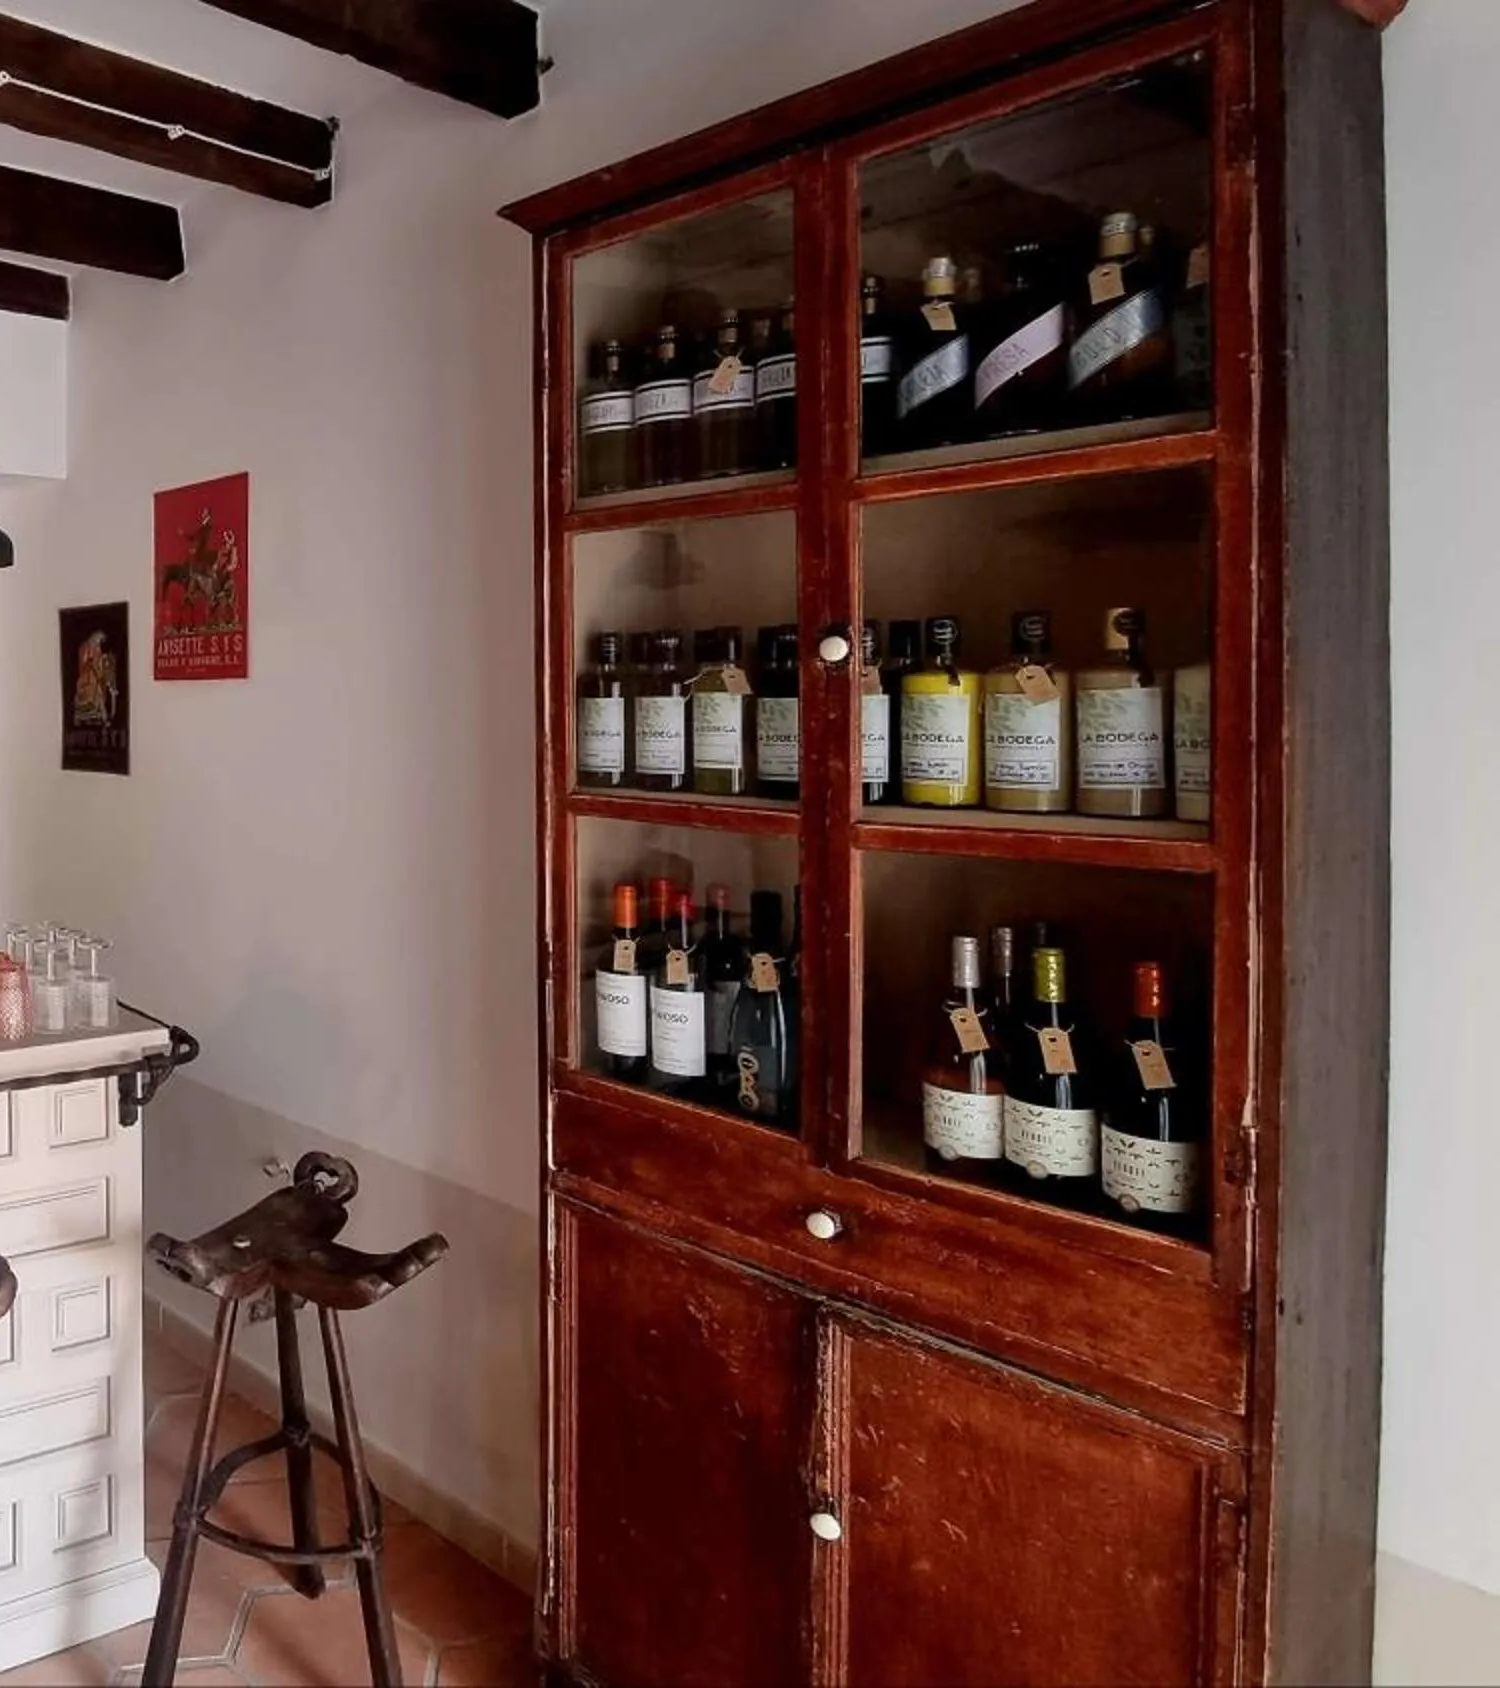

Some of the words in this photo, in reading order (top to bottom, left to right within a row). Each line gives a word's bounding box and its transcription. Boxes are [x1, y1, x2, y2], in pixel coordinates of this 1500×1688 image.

[912, 733, 965, 743] BODEGA
[997, 735, 1055, 745] BODEGA
[1095, 732, 1159, 743] BODEGA
